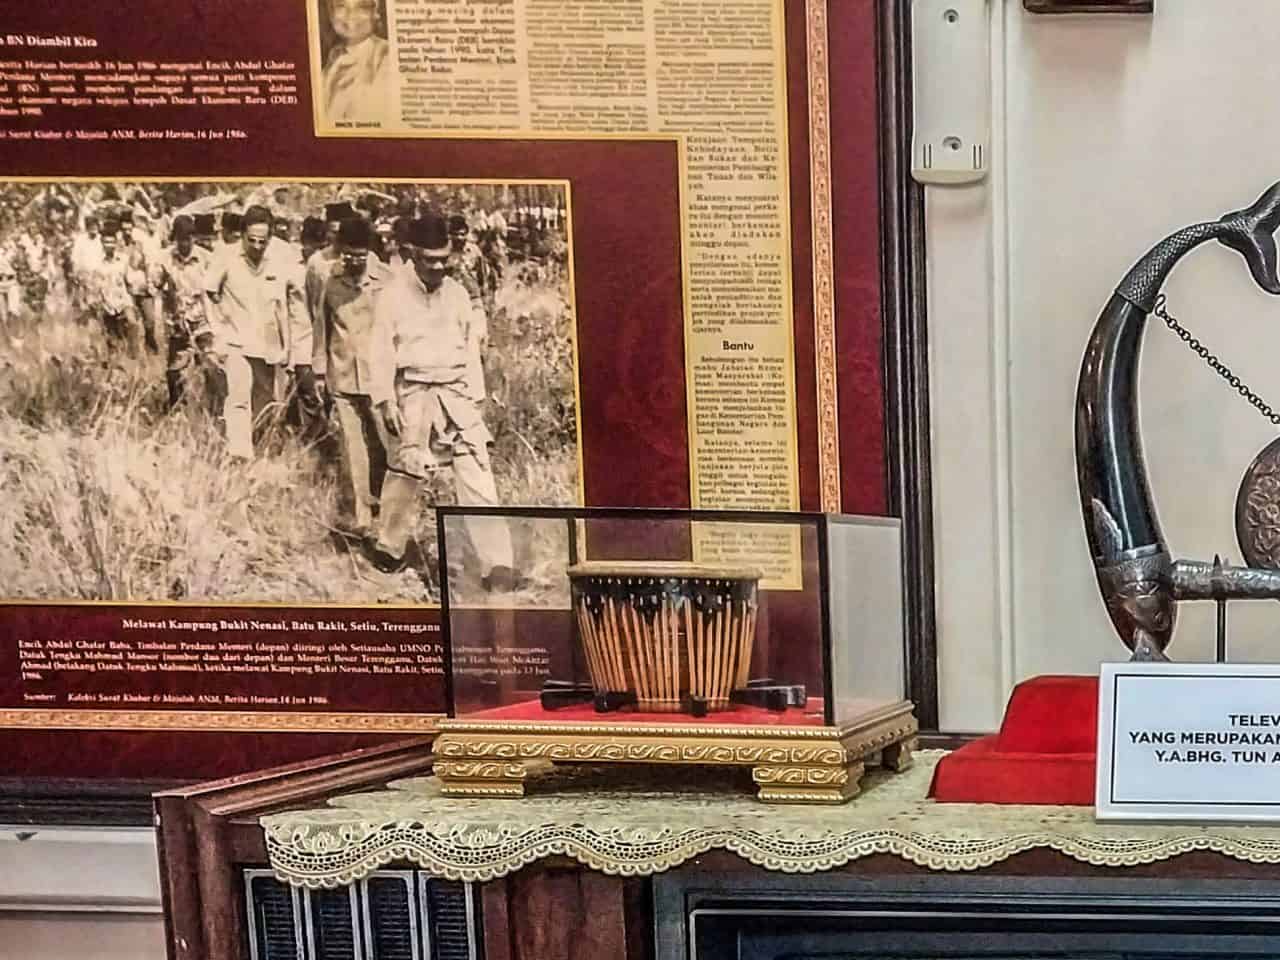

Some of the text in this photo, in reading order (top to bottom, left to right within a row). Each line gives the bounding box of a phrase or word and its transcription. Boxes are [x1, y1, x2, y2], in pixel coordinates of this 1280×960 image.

[26, 36, 71, 47] Diambil
[73, 36, 98, 48] Kira
[723, 340, 754, 351] Bantu
[123, 619, 165, 629] Melawat
[169, 620, 218, 632] Kampung
[220, 620, 247, 630] Bukit
[292, 621, 314, 631] Batu
[317, 621, 347, 632] Rakit,
[382, 622, 440, 634] Terengganu
[1129, 733, 1175, 745] YANG
[1155, 751, 1226, 764] Y.A.BHG.
[1231, 751, 1265, 764] TUN
